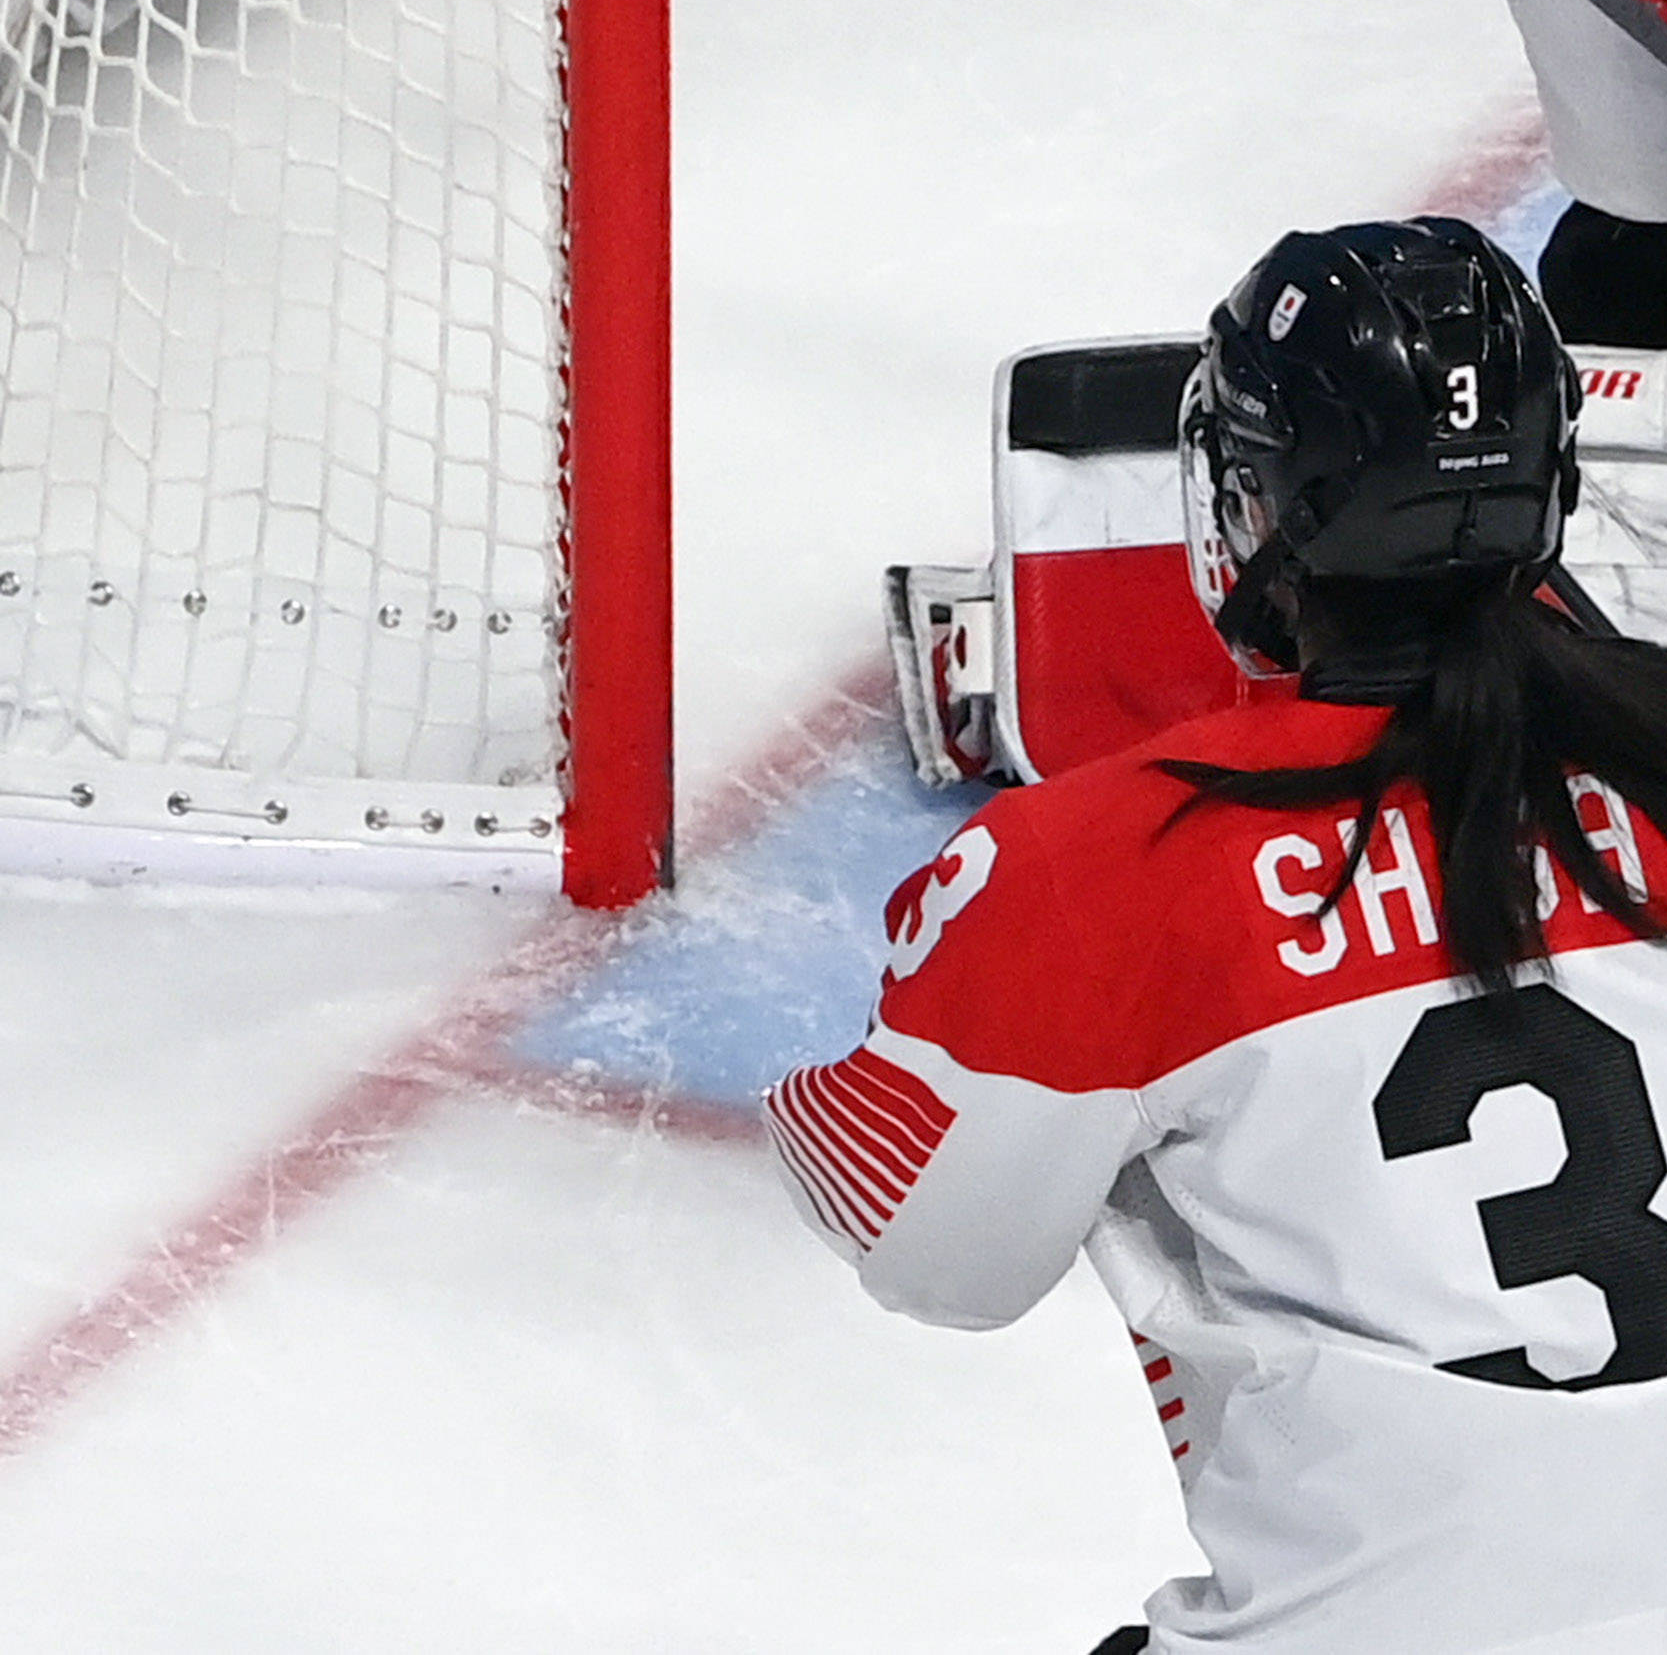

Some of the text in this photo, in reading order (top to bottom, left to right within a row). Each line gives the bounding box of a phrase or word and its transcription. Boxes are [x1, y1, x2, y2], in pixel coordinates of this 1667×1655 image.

[1446, 365, 1479, 430] 3
[885, 825, 998, 981] 3
[1252, 773, 1649, 977] SHA
